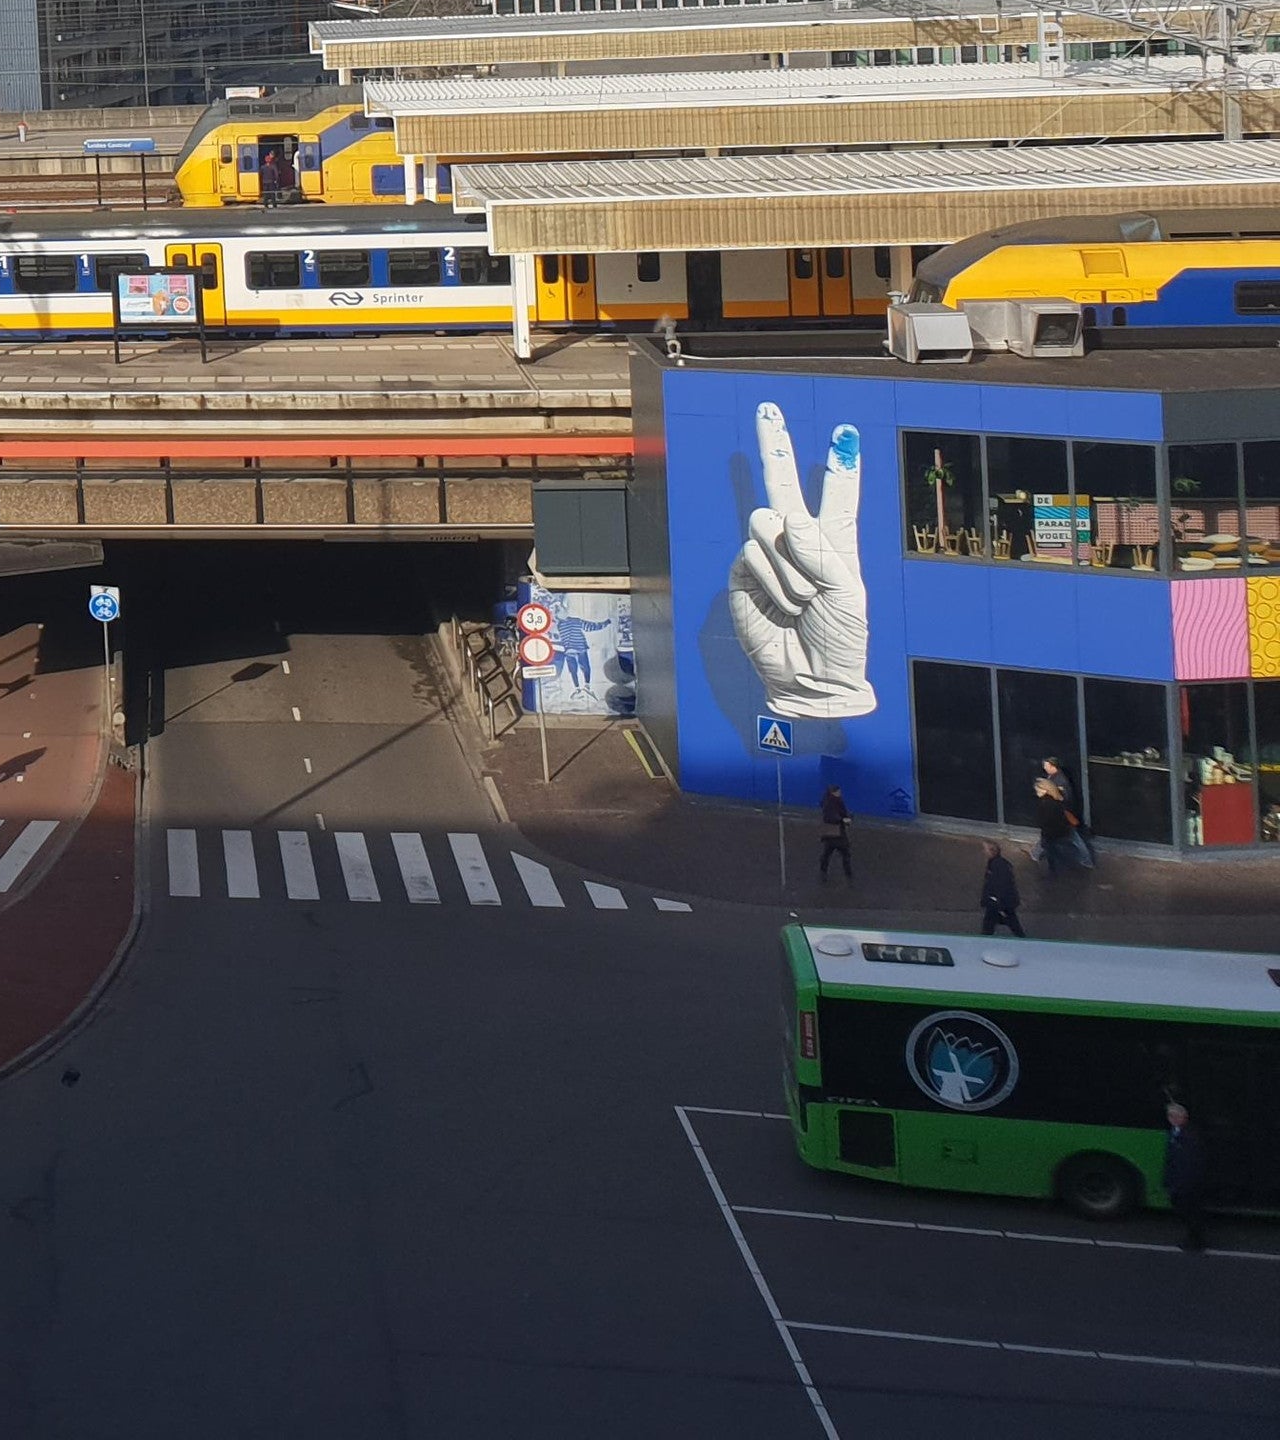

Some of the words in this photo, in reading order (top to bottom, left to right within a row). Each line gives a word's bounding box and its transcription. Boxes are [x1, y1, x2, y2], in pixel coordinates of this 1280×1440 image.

[304, 250, 315, 263] 2
[444, 247, 455, 260] 2
[0, 256, 7, 269] 1
[80, 254, 88, 267] 1
[373, 293, 424, 304] Sprinter
